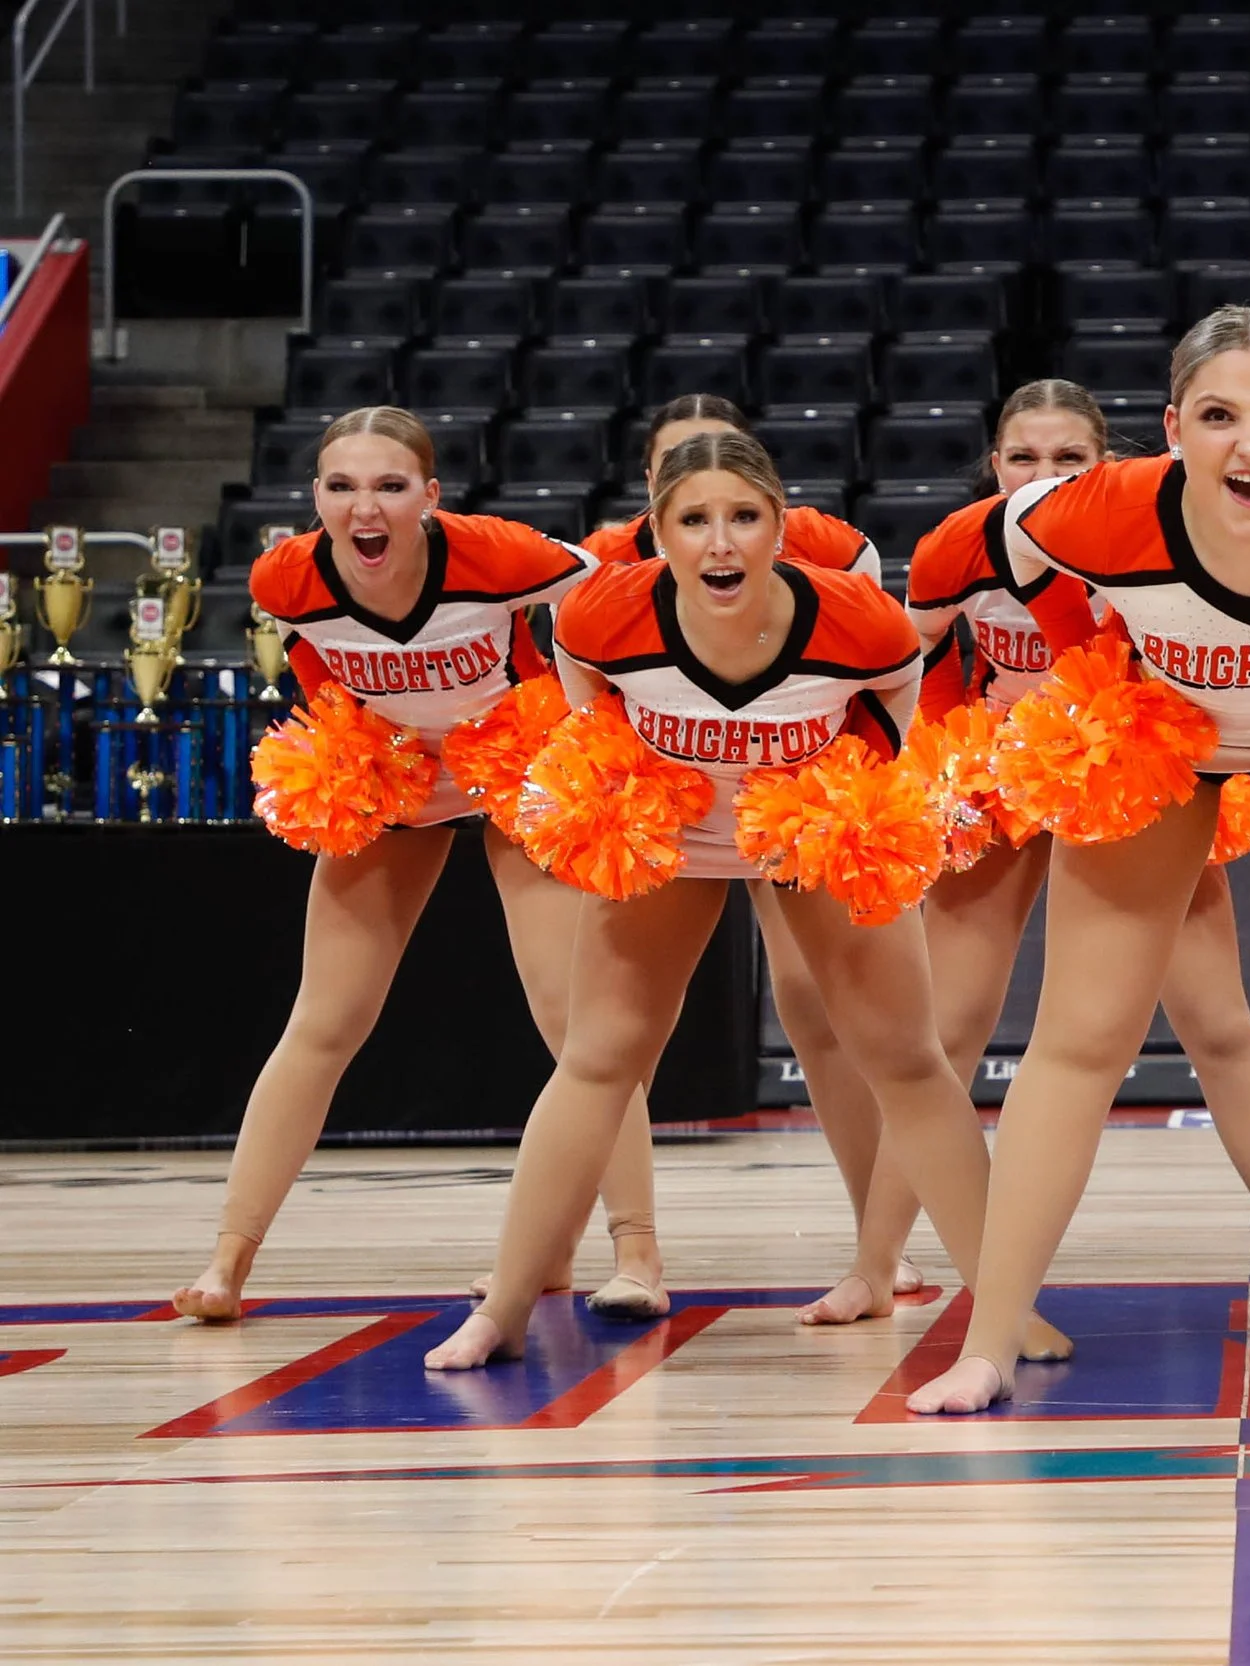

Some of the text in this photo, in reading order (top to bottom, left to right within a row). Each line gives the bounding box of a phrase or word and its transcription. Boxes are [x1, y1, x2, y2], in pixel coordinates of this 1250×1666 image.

[325, 632, 502, 695] BRIGHTON
[975, 619, 1054, 673] BRIG
[637, 705, 834, 766] BRIGHTON
